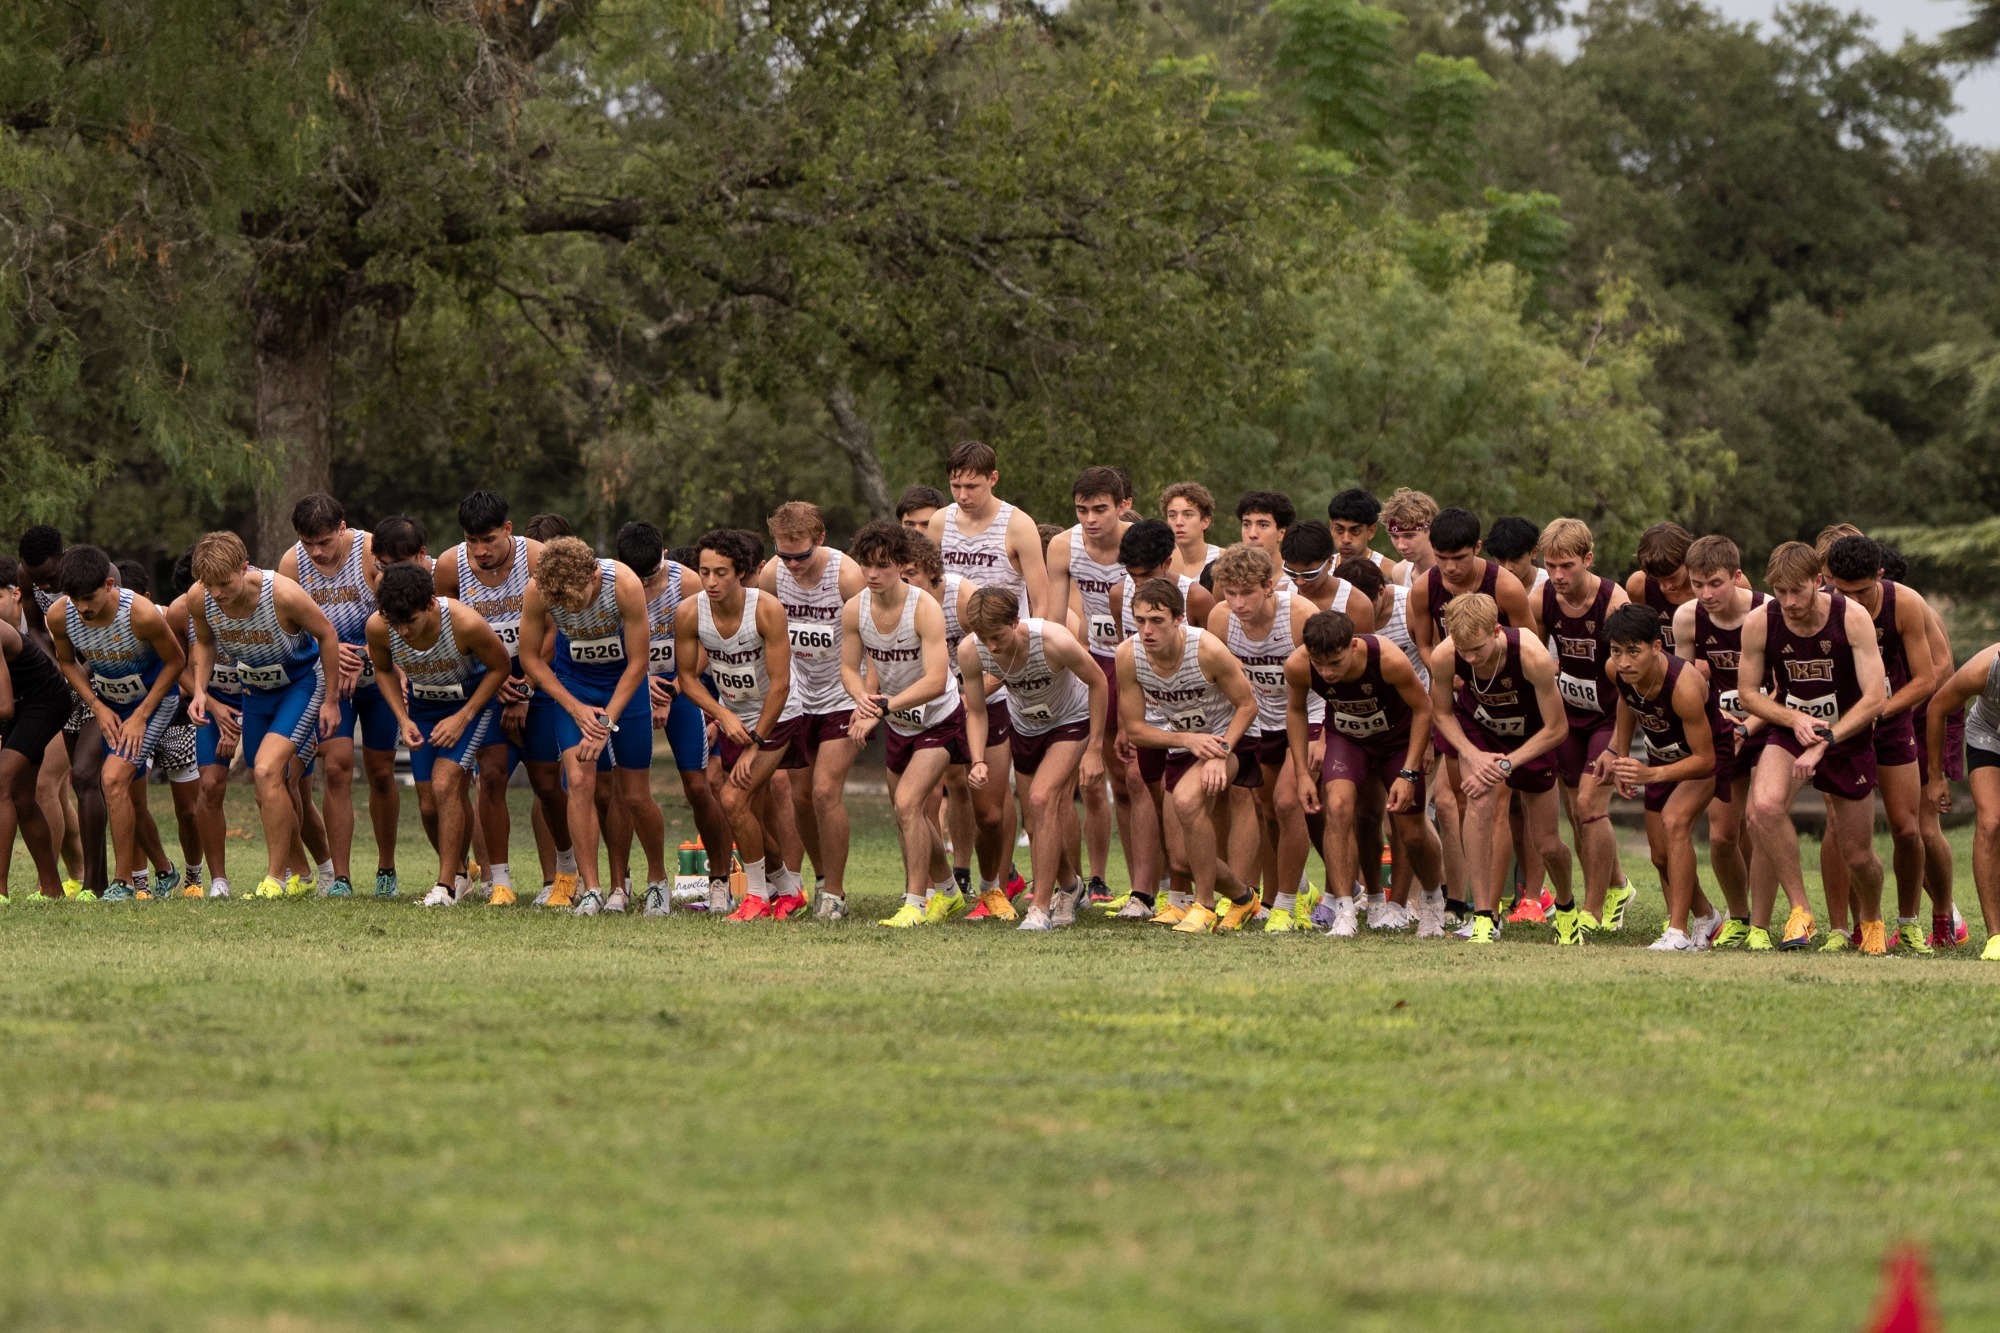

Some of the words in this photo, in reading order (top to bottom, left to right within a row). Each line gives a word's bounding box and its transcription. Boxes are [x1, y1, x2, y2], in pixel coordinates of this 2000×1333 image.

[1078, 579, 1117, 593] TRIN
[789, 629, 832, 648] 7666
[572, 643, 620, 660] 7526
[650, 645, 672, 661] 29
[704, 646, 762, 665] TRINITY
[866, 646, 921, 662] TRINITY
[1236, 655, 1288, 666] RINIT
[239, 668, 282, 681] 7527
[1245, 667, 1285, 686] 7657
[1784, 659, 1834, 682] TXST
[96, 680, 140, 694] 7531
[713, 669, 754, 689] 7669
[414, 688, 459, 699] 7521
[1560, 679, 1596, 701] 7618
[1336, 717, 1384, 730] 7619
